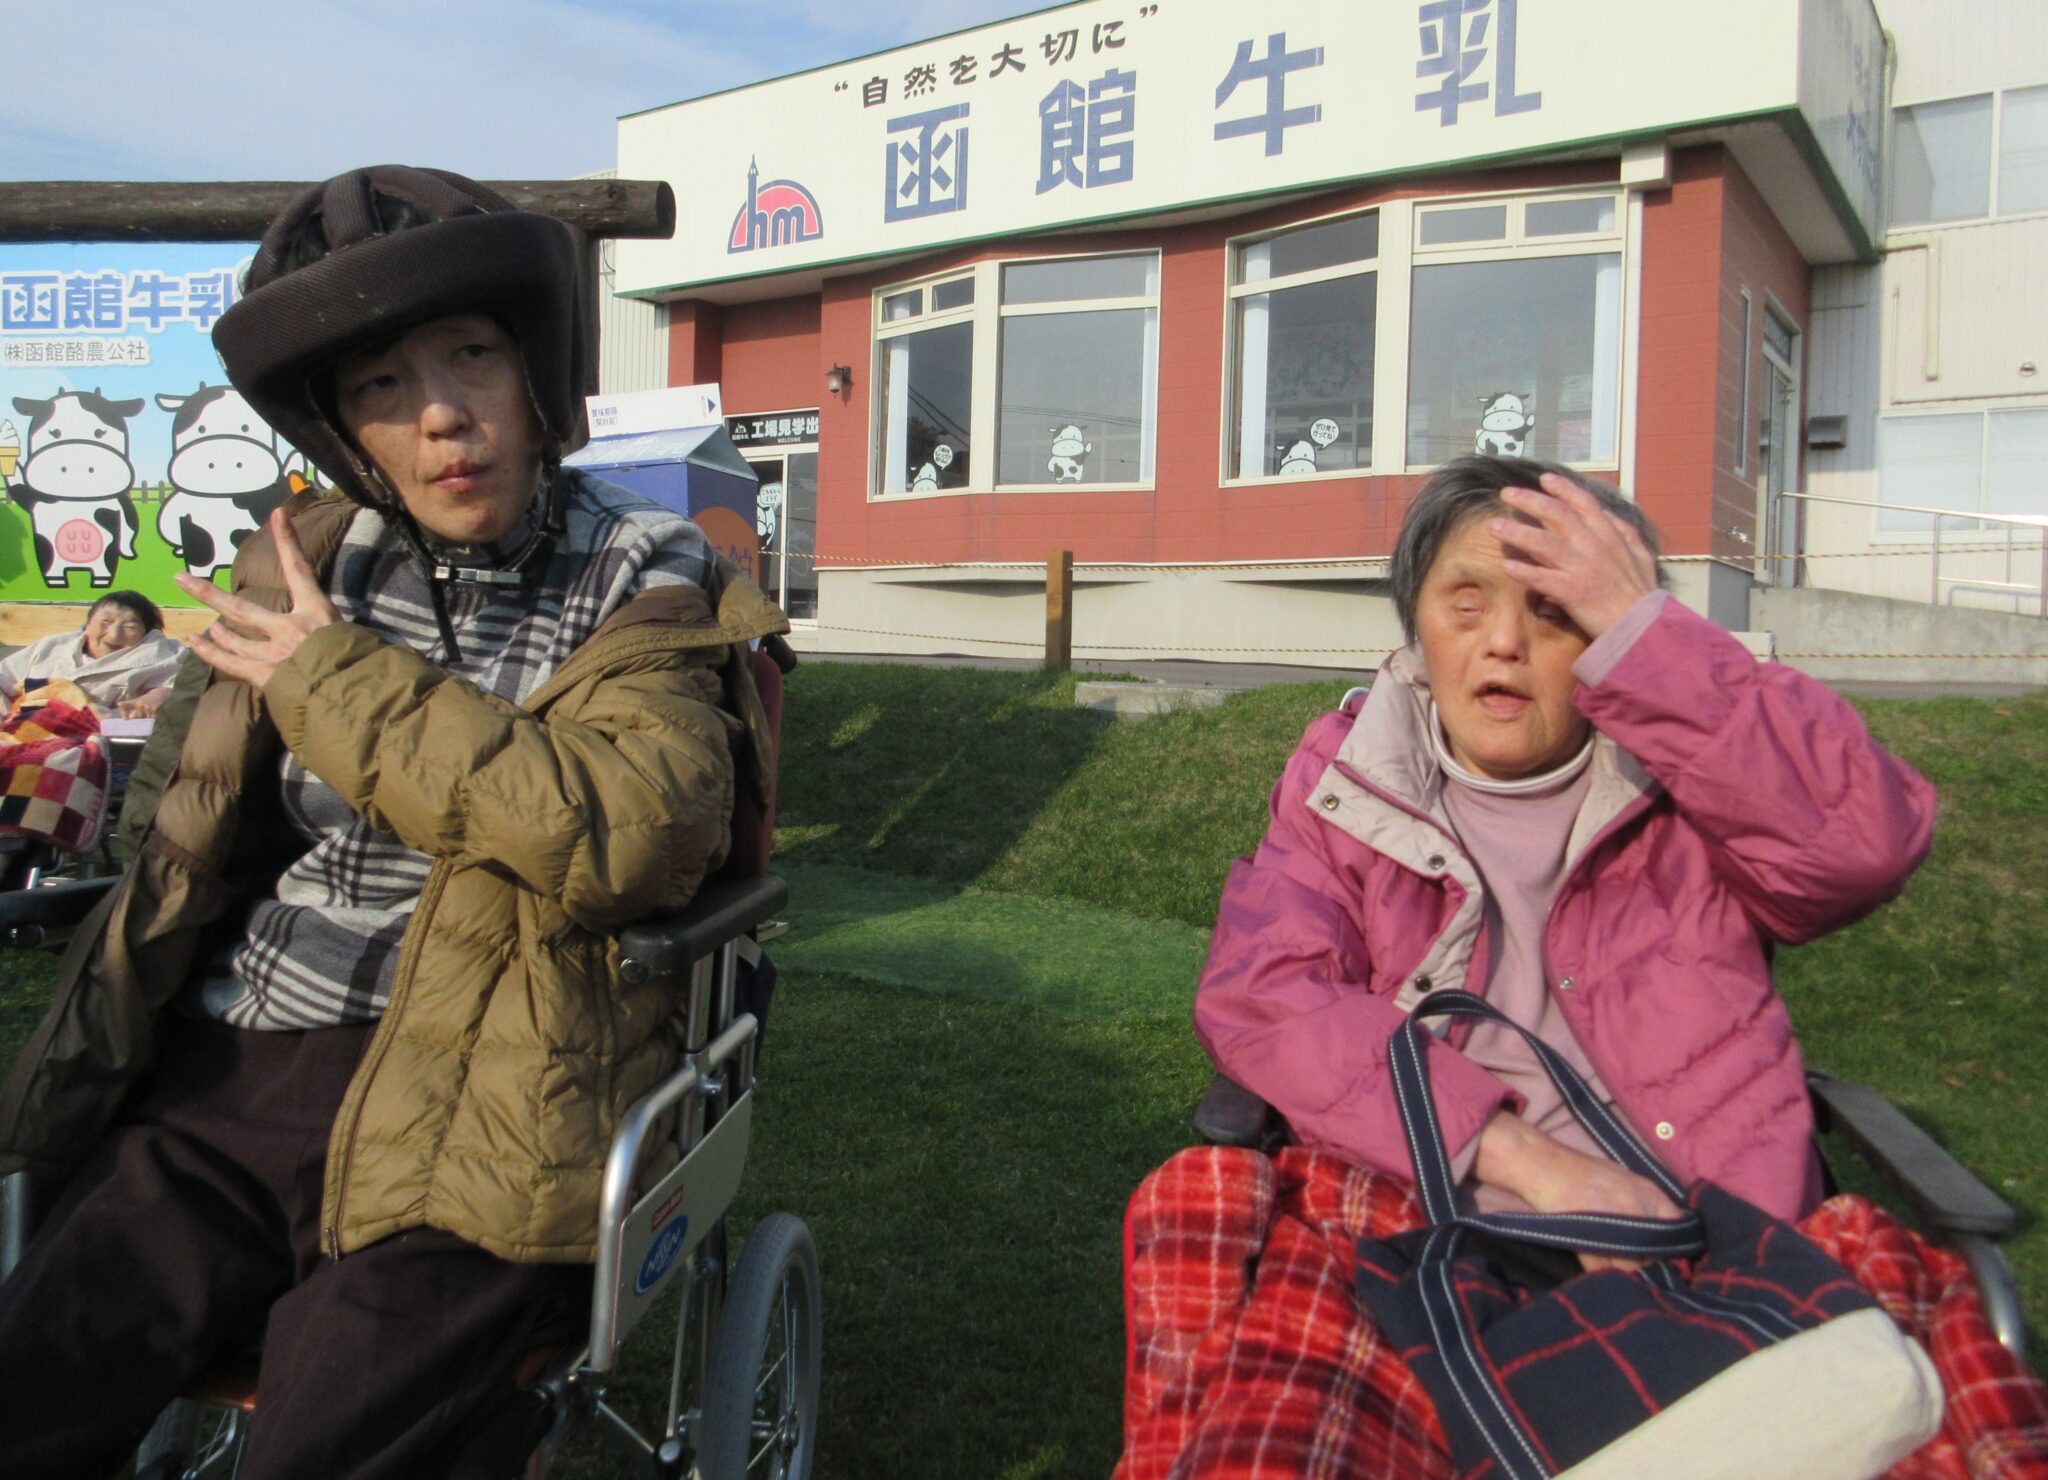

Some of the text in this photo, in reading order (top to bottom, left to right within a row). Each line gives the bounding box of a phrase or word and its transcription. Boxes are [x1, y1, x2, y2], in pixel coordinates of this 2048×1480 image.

[884, 0, 1541, 223] 函館牛乳
[3, 273, 234, 330] 函館牛乳
